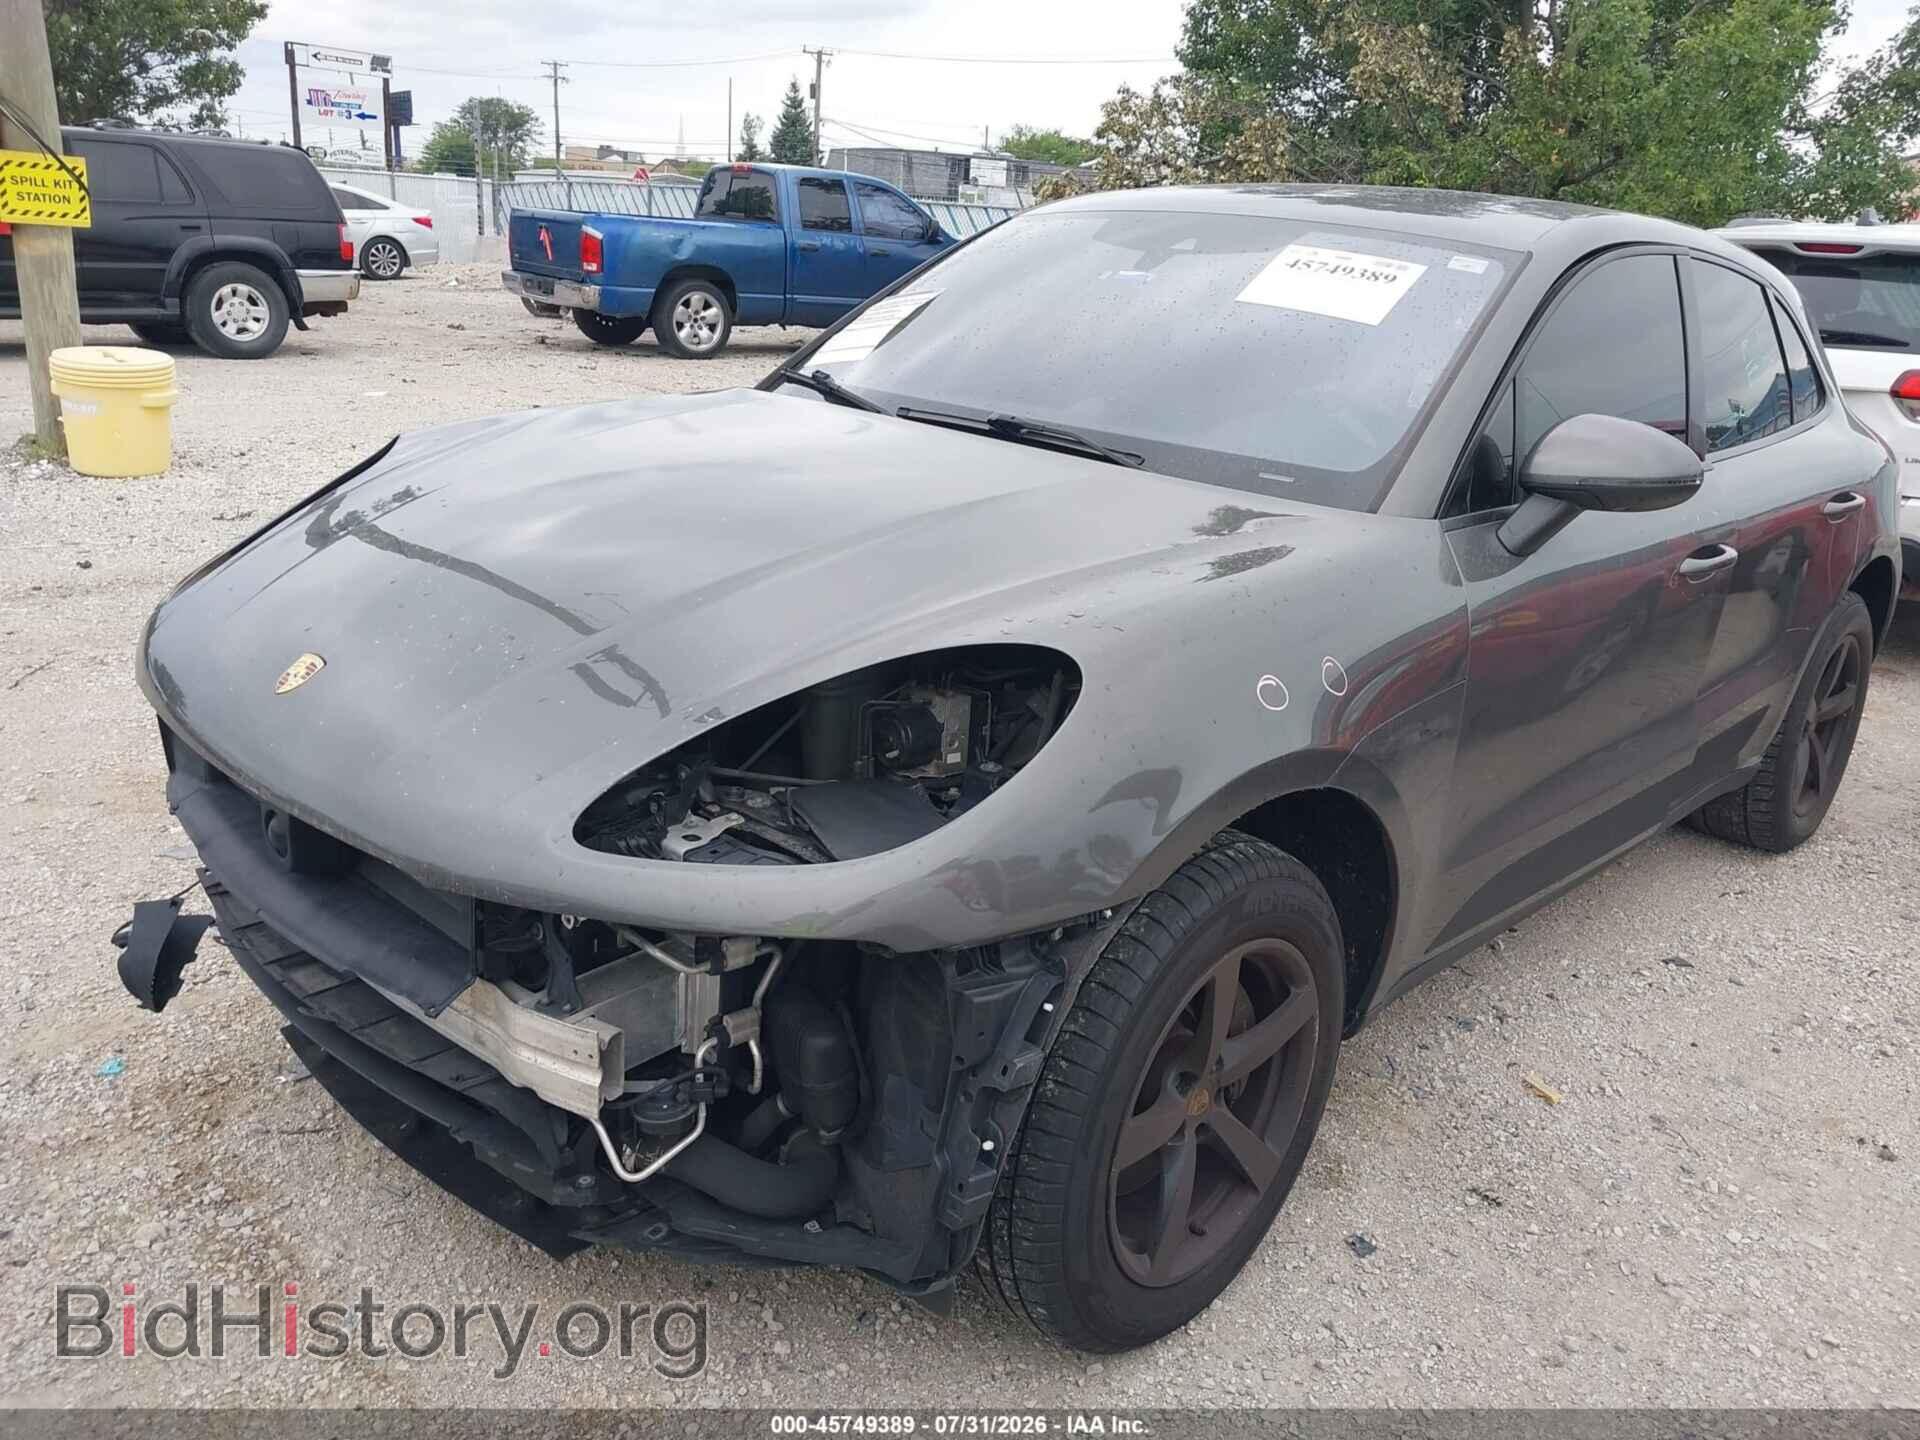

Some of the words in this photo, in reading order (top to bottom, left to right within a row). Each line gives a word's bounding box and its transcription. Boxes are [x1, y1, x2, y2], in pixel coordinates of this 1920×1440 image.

[318, 108, 335, 117] LOT
[9, 175, 49, 188] SPILL
[53, 178, 74, 190] KIT
[16, 191, 72, 205] STATION
[1284, 258, 1398, 284] 45749389
